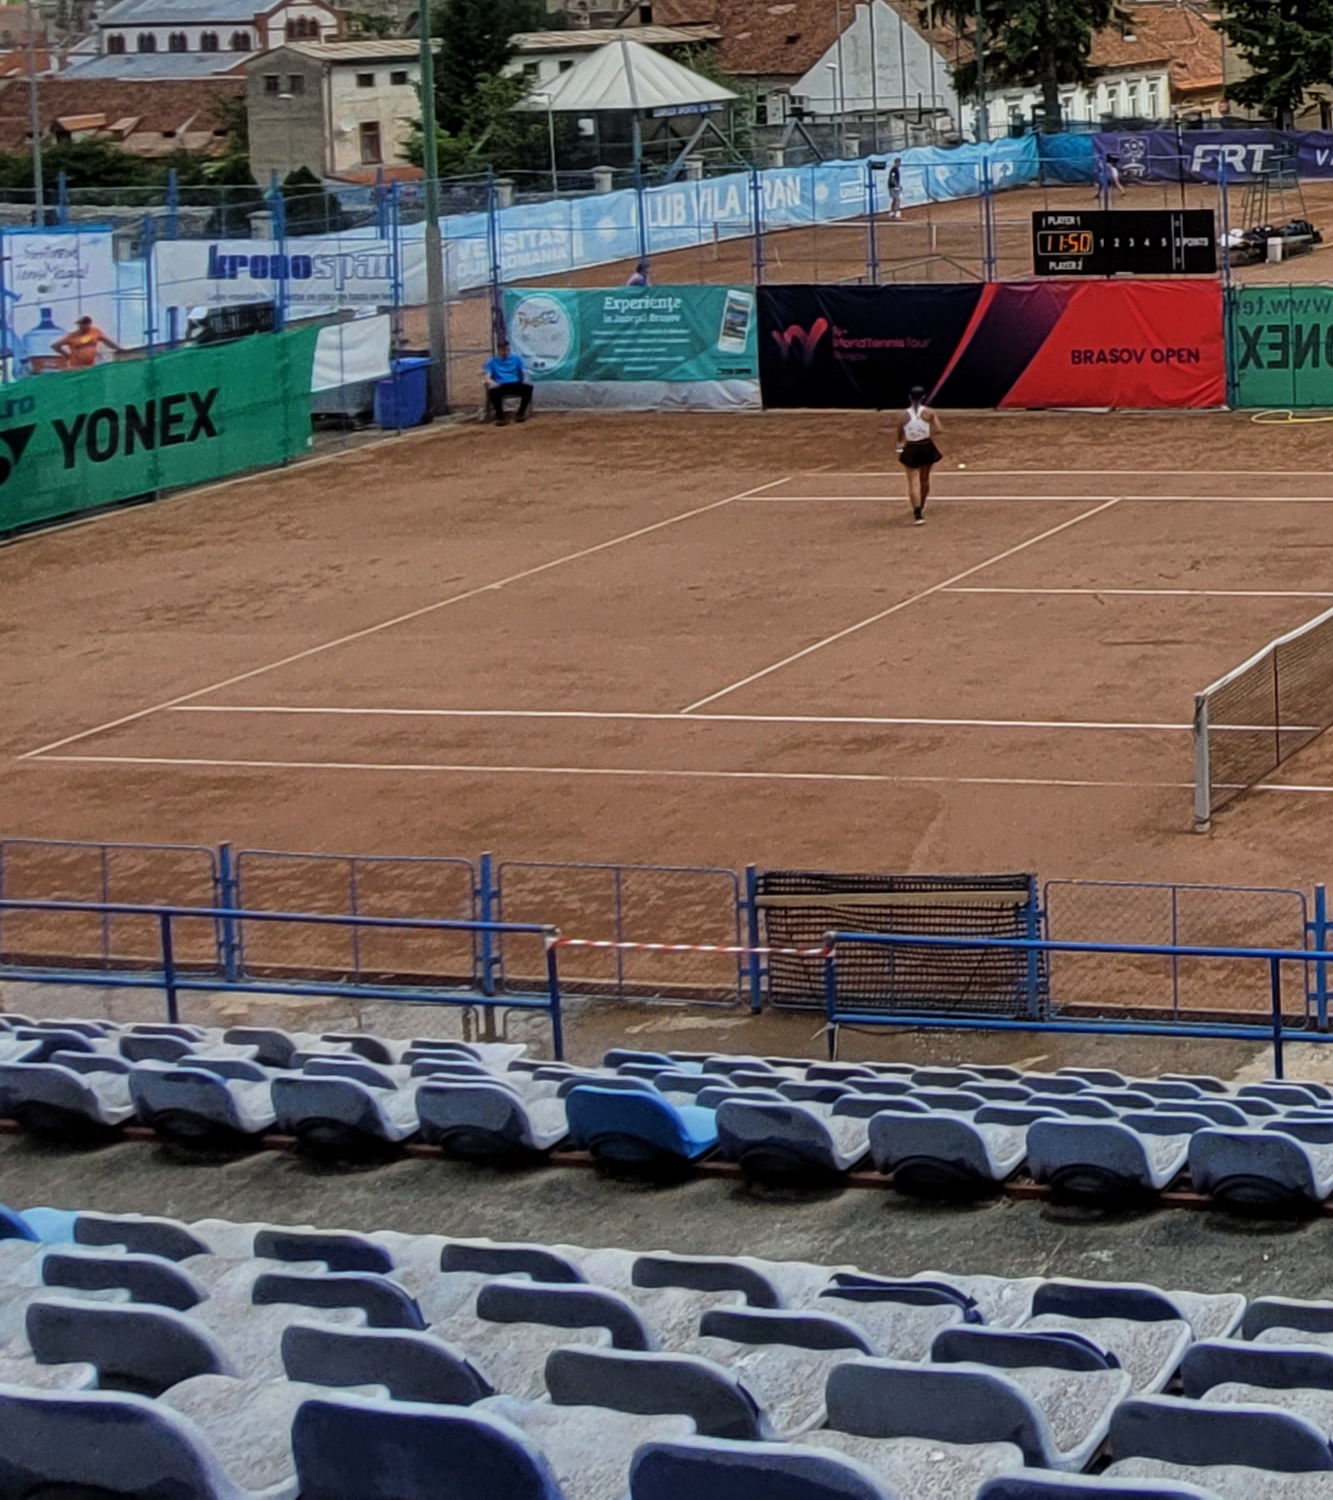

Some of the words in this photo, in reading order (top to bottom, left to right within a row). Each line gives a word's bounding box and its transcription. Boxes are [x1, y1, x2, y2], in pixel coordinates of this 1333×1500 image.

[1191, 144, 1275, 173] FRT
[690, 184, 742, 221] VILA
[747, 175, 801, 213] RAN
[1047, 216, 1076, 226] PLAYER
[457, 228, 568, 260] VESITAS
[1114, 238, 1120, 248] 2
[1129, 238, 1135, 248] 3
[1144, 238, 1150, 248] 4
[1049, 261, 1077, 271] PLAYER
[1071, 347, 1147, 365] BRASOV
[1151, 347, 1200, 364] OPEN
[51, 387, 219, 470] YONEX
